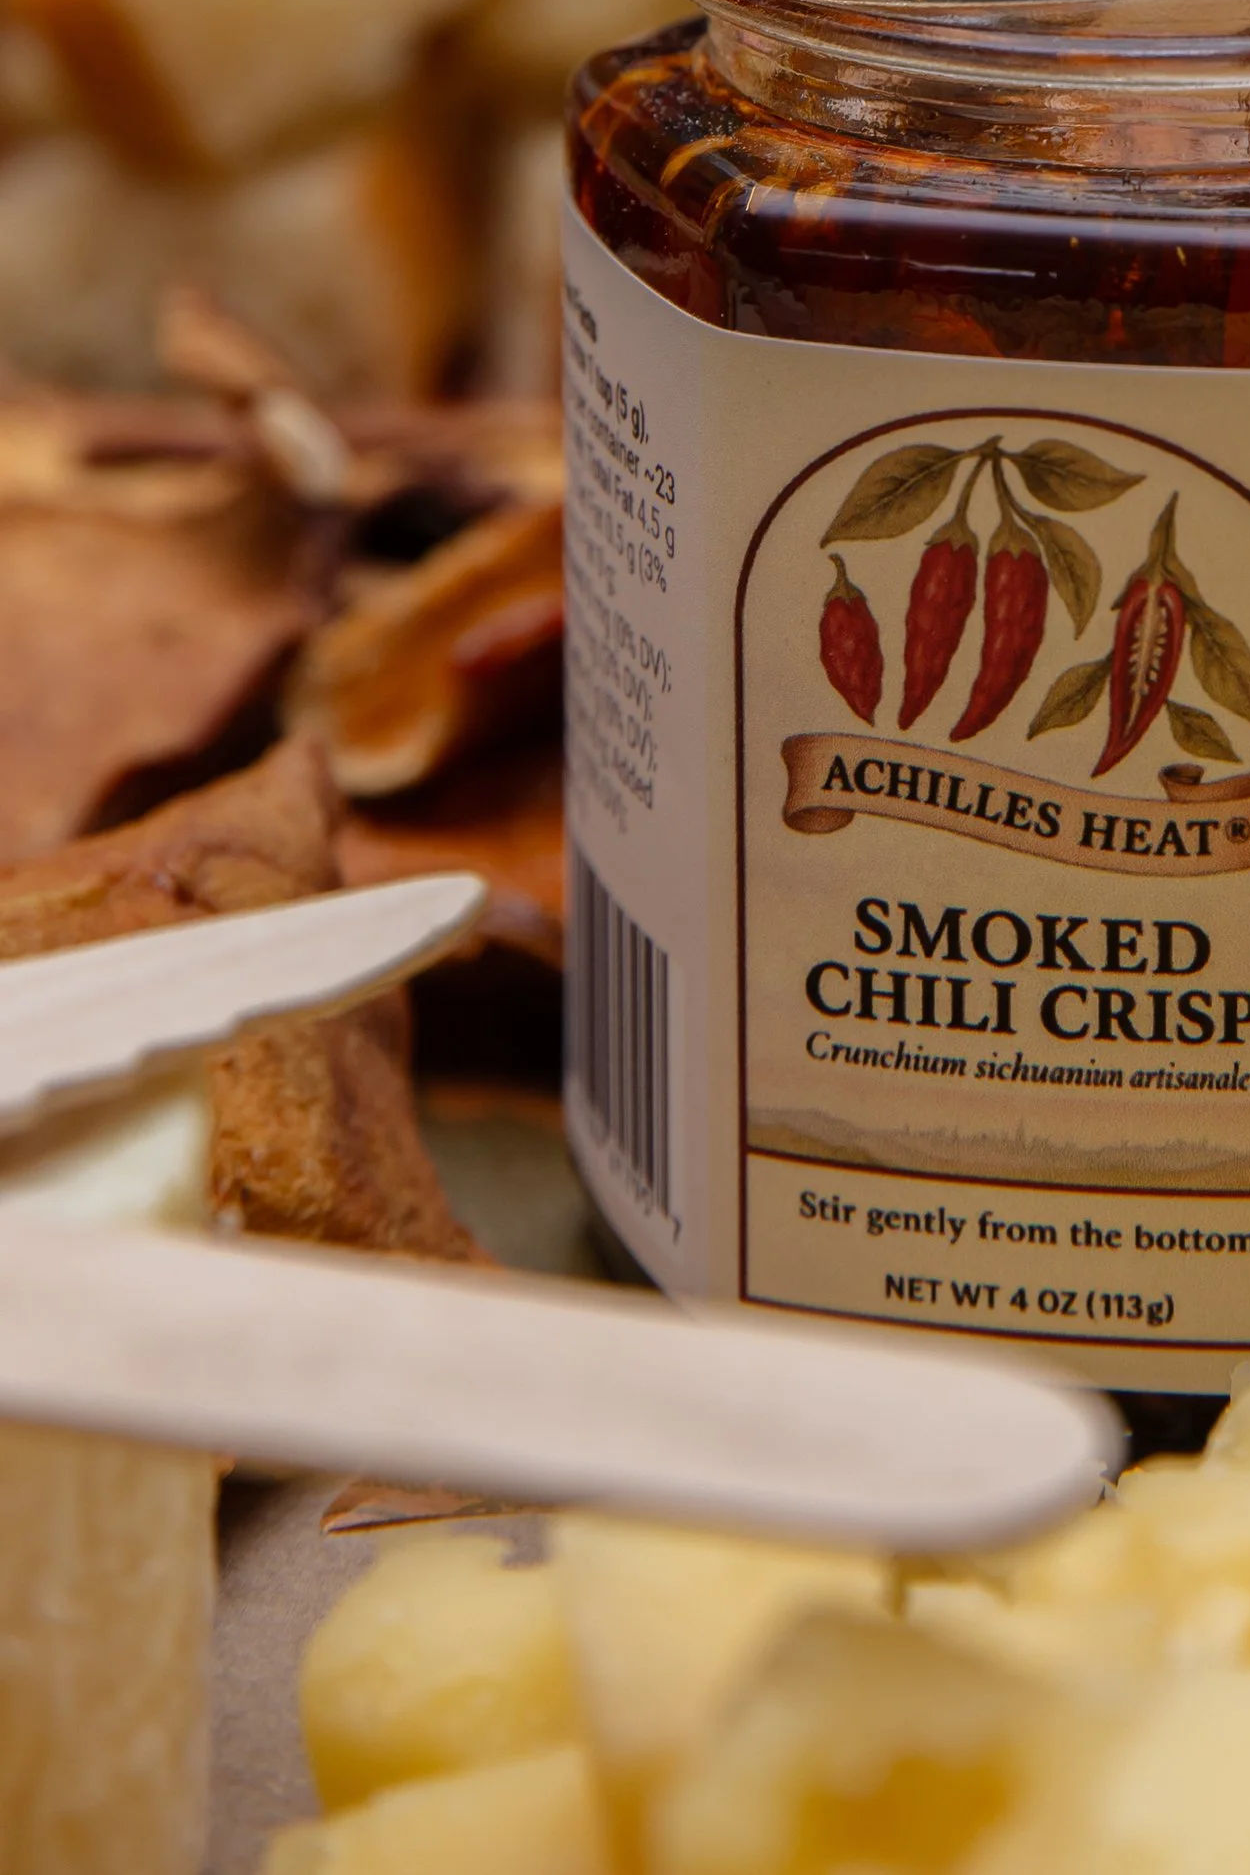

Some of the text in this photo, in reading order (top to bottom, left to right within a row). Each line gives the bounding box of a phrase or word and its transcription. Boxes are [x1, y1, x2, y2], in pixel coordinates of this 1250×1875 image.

[614, 474, 634, 519] Fat
[637, 498, 660, 539] 4.5
[665, 526, 675, 559] g
[644, 464, 675, 505] ~23
[821, 754, 1062, 838] ACHILLES
[853, 897, 1211, 976] SMOKED
[805, 960, 1018, 1034] CHILI
[805, 1030, 968, 1077] Crunchium
[799, 1190, 857, 1225] Stir
[866, 1206, 967, 1244] gently
[977, 1210, 1058, 1246] from
[1069, 1220, 1123, 1249] the
[885, 1273, 943, 1304] NET
[950, 1281, 1000, 1310] WT
[1009, 1287, 1029, 1313] 4
[1038, 1289, 1079, 1317] OZ
